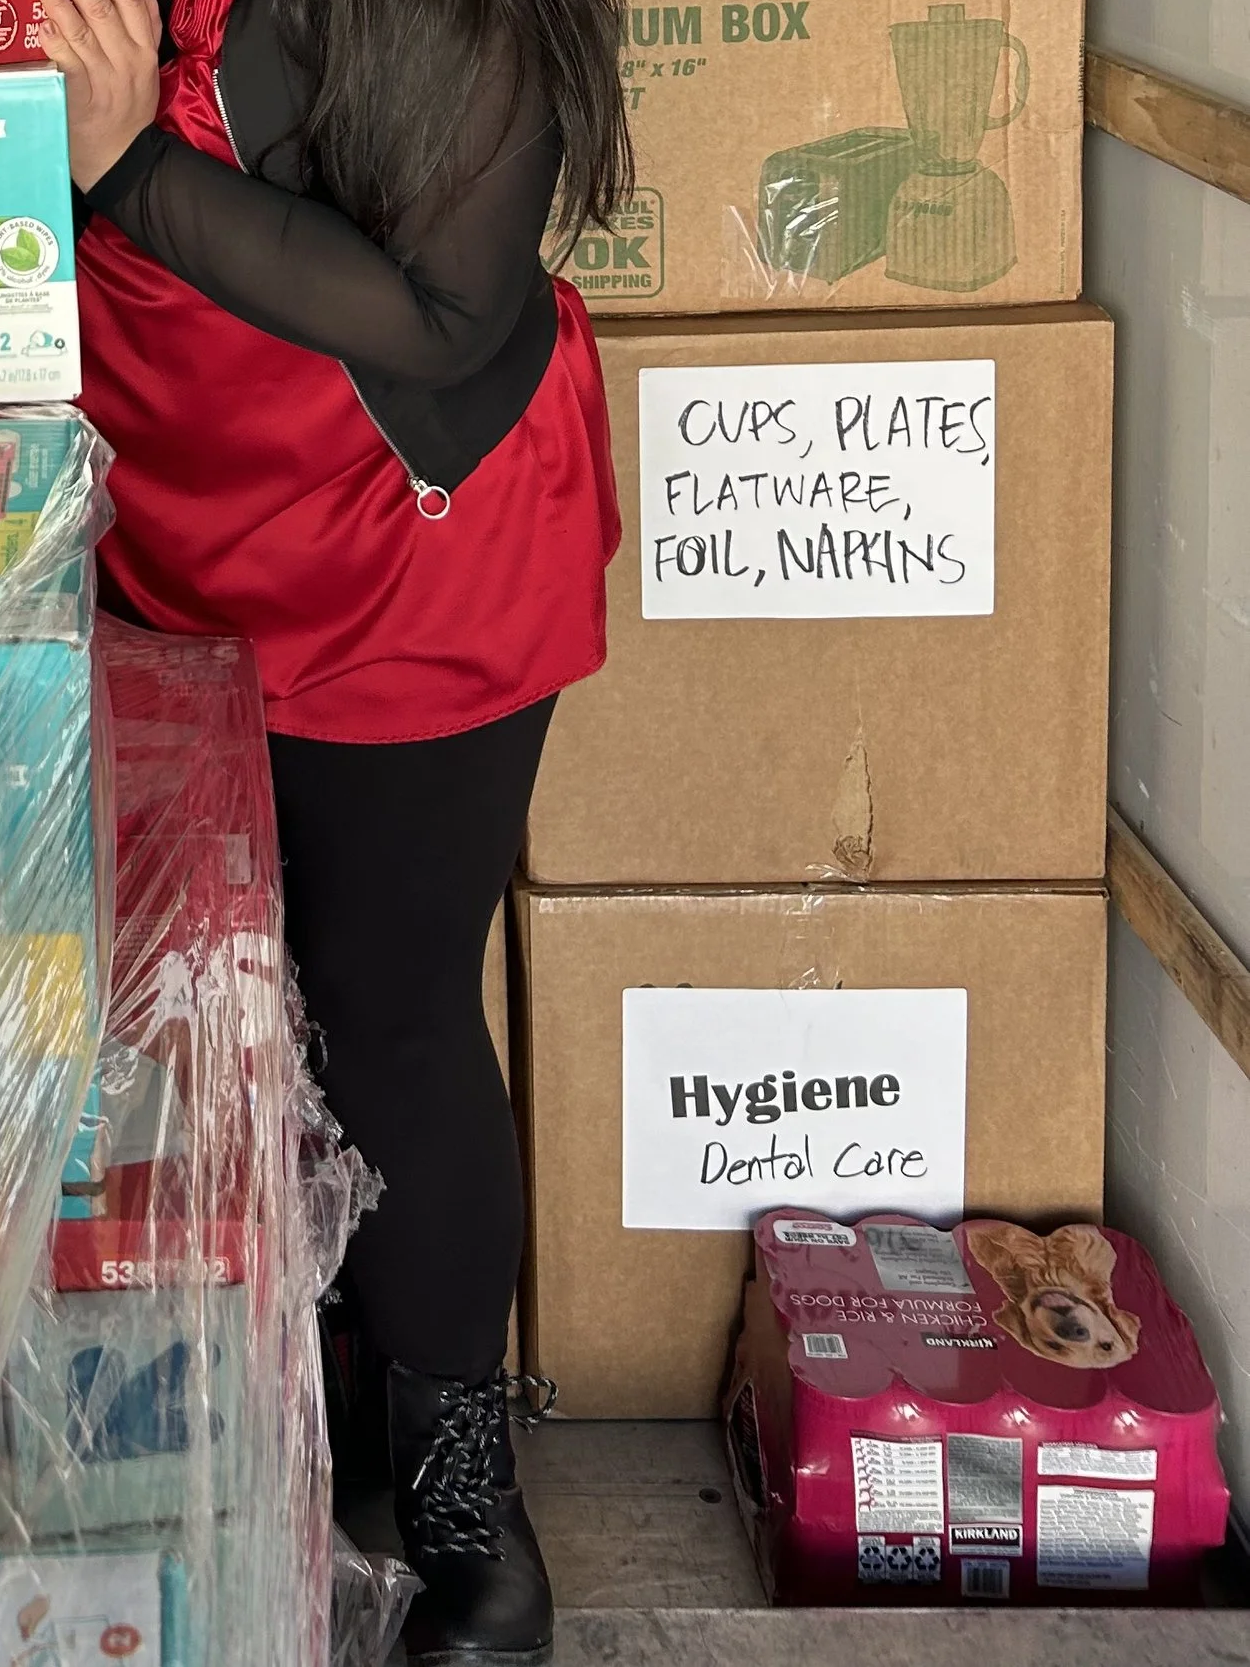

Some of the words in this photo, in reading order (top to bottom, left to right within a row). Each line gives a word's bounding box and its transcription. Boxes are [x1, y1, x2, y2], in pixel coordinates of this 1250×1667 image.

[721, 1, 811, 43] BOX
[621, 59, 646, 78] 8"
[650, 63, 663, 78] x
[671, 57, 706, 76] 16"
[35, 224, 54, 248] WIPES
[573, 236, 653, 271] OK
[571, 273, 652, 290] SHIPPING
[677, 399, 814, 458] CUPS,
[835, 395, 992, 466] PLATES,
[665, 470, 912, 521] FLATWARE,
[654, 531, 766, 587] FOIL,
[777, 523, 966, 584] NAPKINS
[669, 1070, 901, 1126] Hygiene
[700, 1133, 814, 1186] Dental
[834, 1141, 928, 1179] Care
[790, 1294, 845, 1307] DOGS
[851, 1296, 888, 1309] FOR
[891, 1299, 982, 1312] FORMULA
[837, 1309, 877, 1323] RICE
[880, 1311, 894, 1323] &
[901, 1313, 988, 1327] CHICKEN
[926, 1337, 994, 1348] KIRKLAND
[953, 1528, 1019, 1541] KIRKLAND
